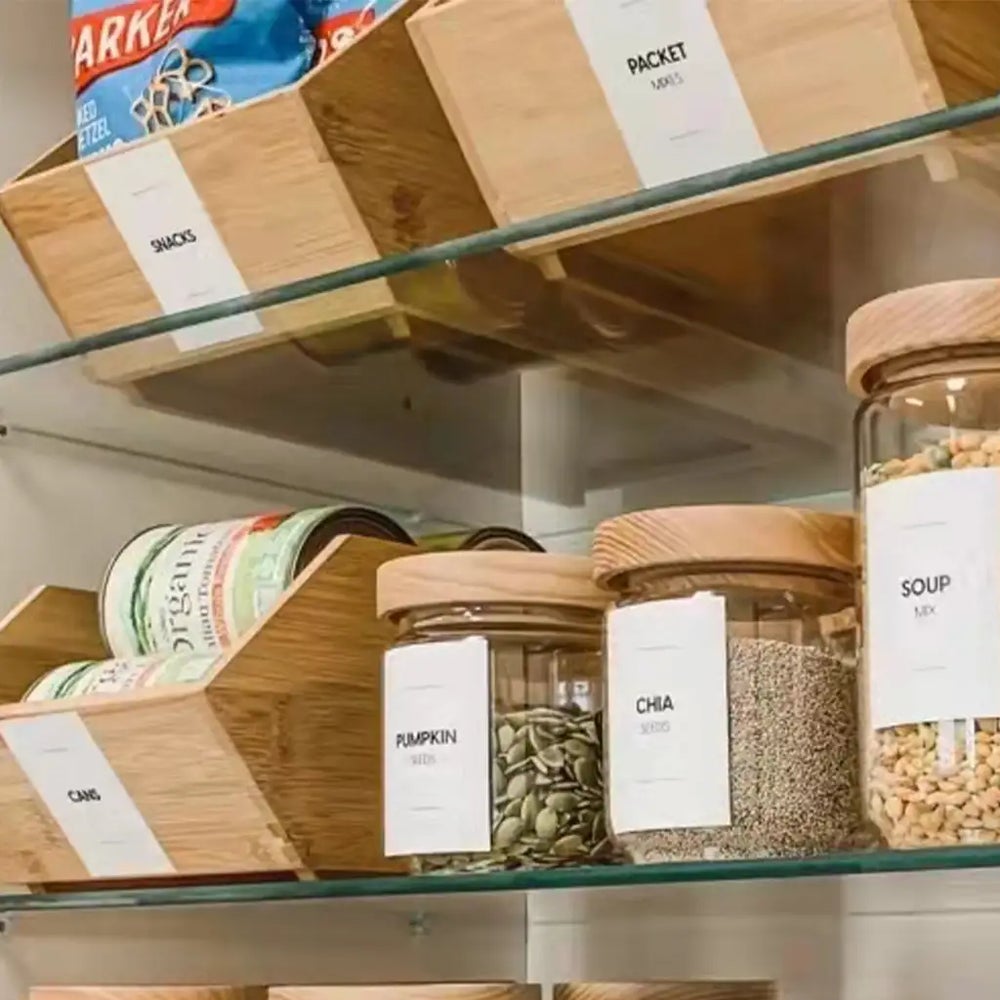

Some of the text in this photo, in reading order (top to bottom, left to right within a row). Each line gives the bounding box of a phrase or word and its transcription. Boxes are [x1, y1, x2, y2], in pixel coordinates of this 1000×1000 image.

[627, 42, 687, 75] PACKET
[150, 229, 197, 253] SNACKS
[901, 575, 951, 598] SOUP
[636, 695, 674, 714] CHIA
[396, 729, 457, 748] PUMPKIN
[67, 788, 101, 803] CANS
